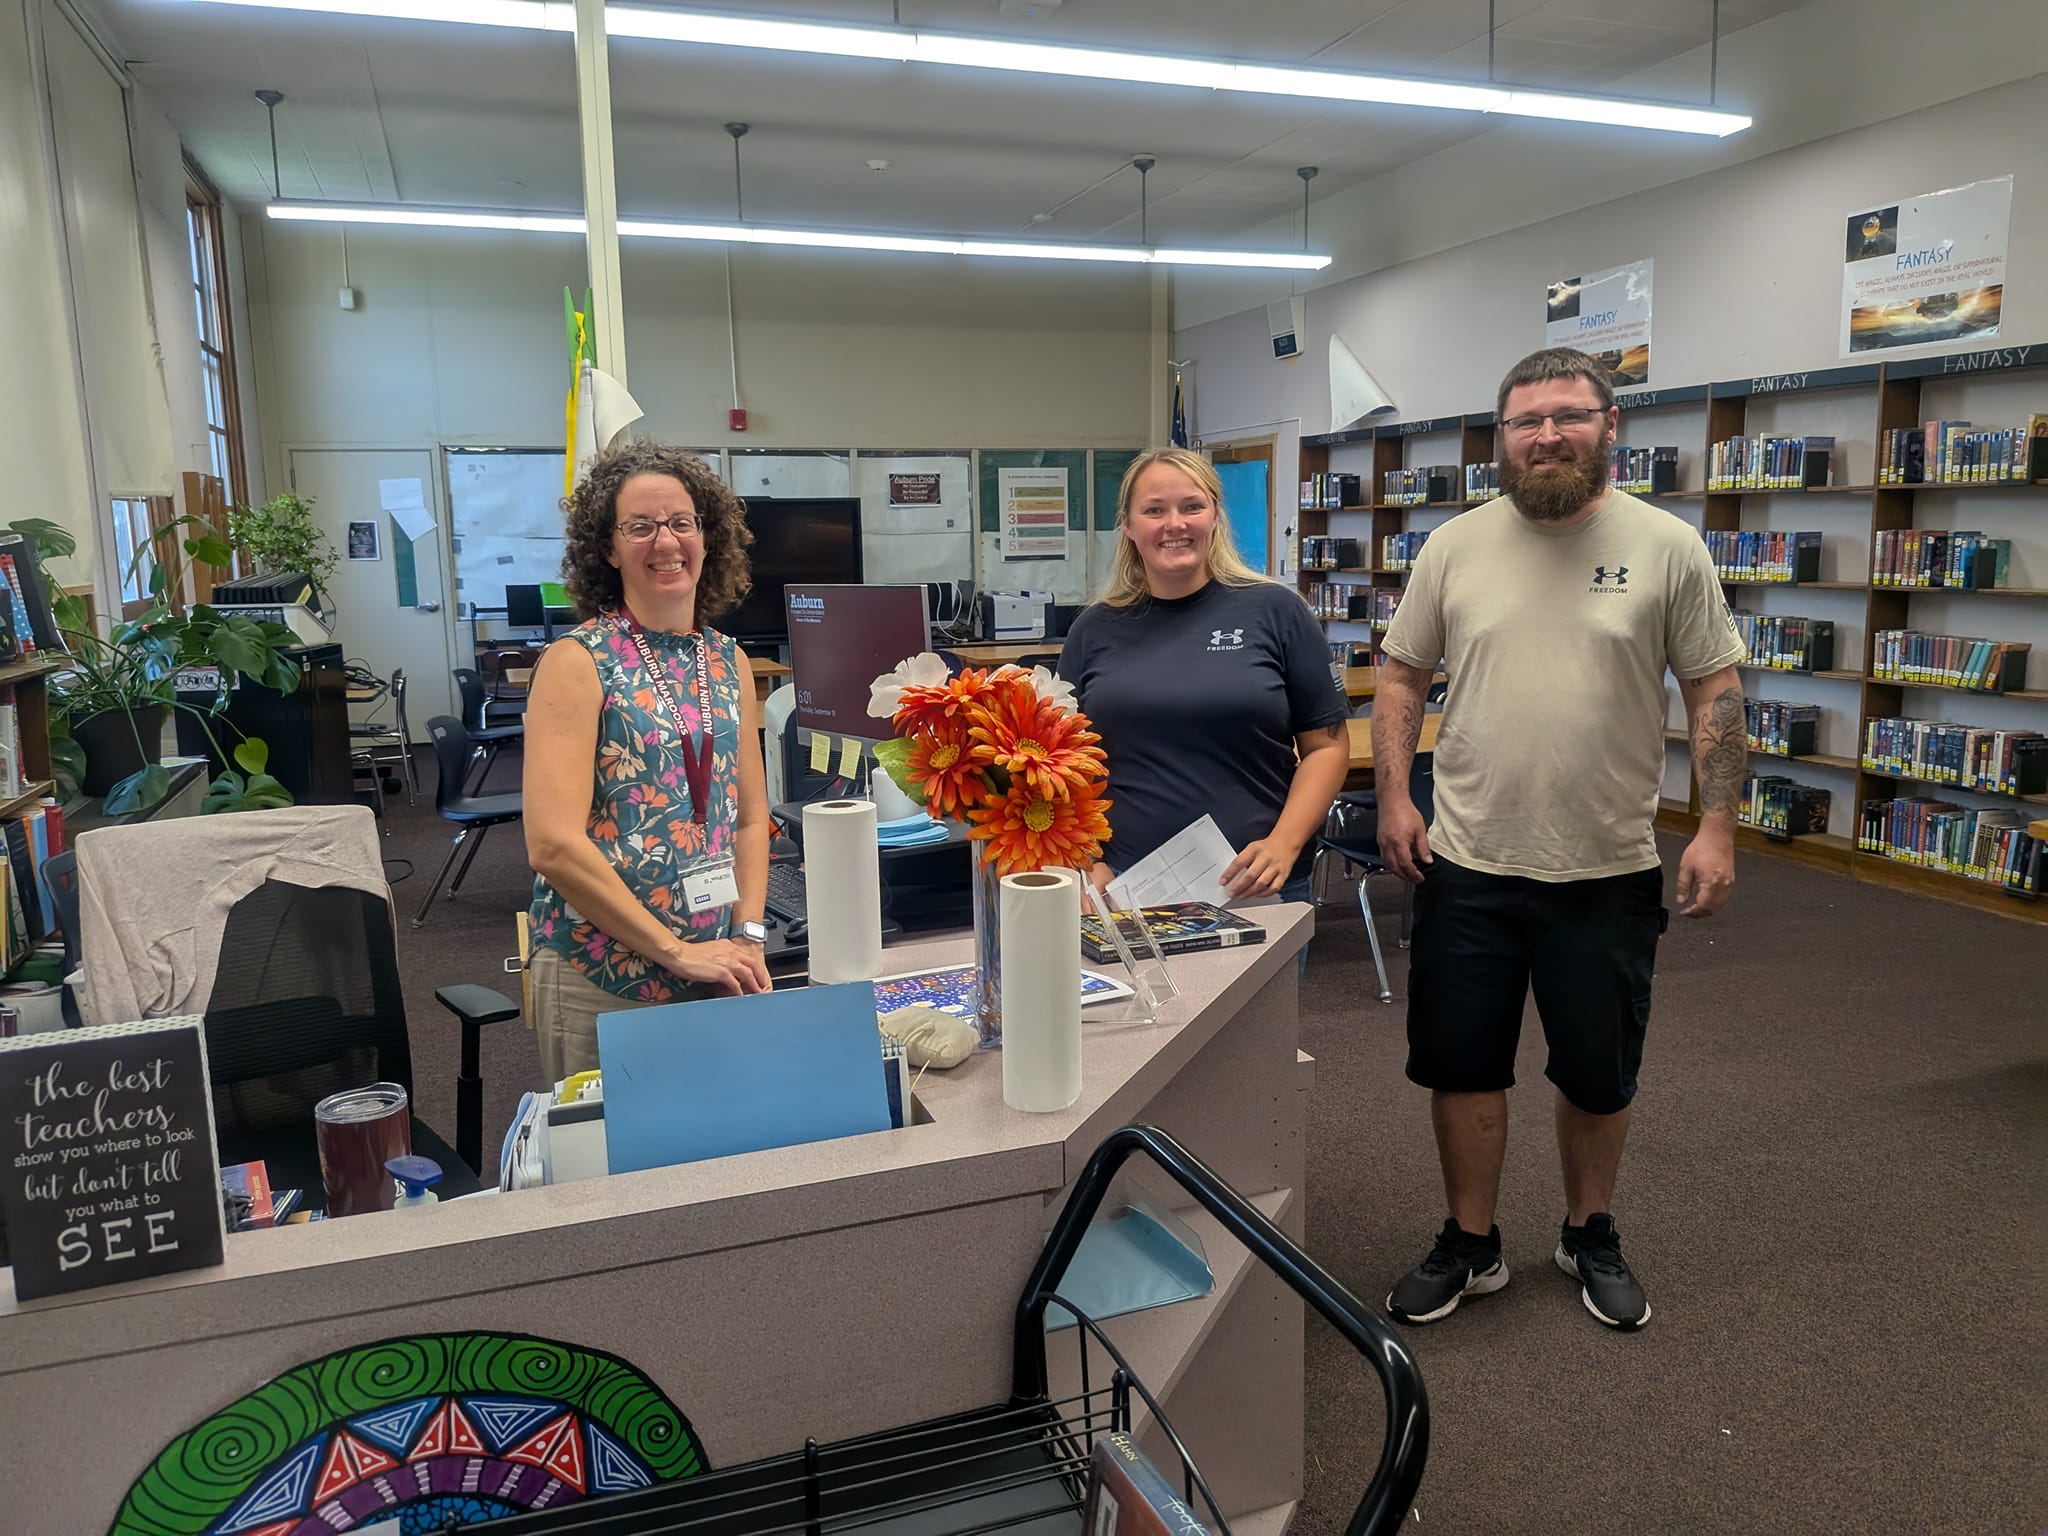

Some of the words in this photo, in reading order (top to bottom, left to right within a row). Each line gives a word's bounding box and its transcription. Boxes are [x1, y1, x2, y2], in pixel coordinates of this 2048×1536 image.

[1896, 247, 1953, 270] FANTASY
[1579, 310, 1618, 330] FANTASY
[1943, 346, 2031, 373] FANTASY
[1752, 374, 1809, 394] FANTASY
[1615, 392, 1657, 409] ANTASY
[1009, 487, 1013, 497] 1
[1008, 501, 1016, 511] 2
[1008, 513, 1016, 524] 3
[1008, 527, 1016, 538] 4
[1008, 541, 1016, 551] 5
[790, 593, 825, 609] Auburn
[696, 633, 707, 688] MAROONS
[632, 633, 662, 679] AUBURN
[656, 679, 689, 736] MAROONS
[700, 689, 713, 735] AUBURN
[25, 1061, 95, 1106] the
[109, 1058, 174, 1093] best
[14, 1088, 175, 1150] teachers
[14, 1151, 54, 1168] show
[60, 1145, 90, 1164] you
[94, 1135, 141, 1154] where
[146, 1132, 162, 1147] to
[166, 1127, 196, 1144] look
[24, 1172, 65, 1201] but
[72, 1157, 133, 1196] don't
[138, 1149, 182, 1183] tell
[65, 1205, 95, 1222] you
[100, 1195, 140, 1213] what
[145, 1193, 161, 1206] to
[56, 1210, 179, 1272] SEE
